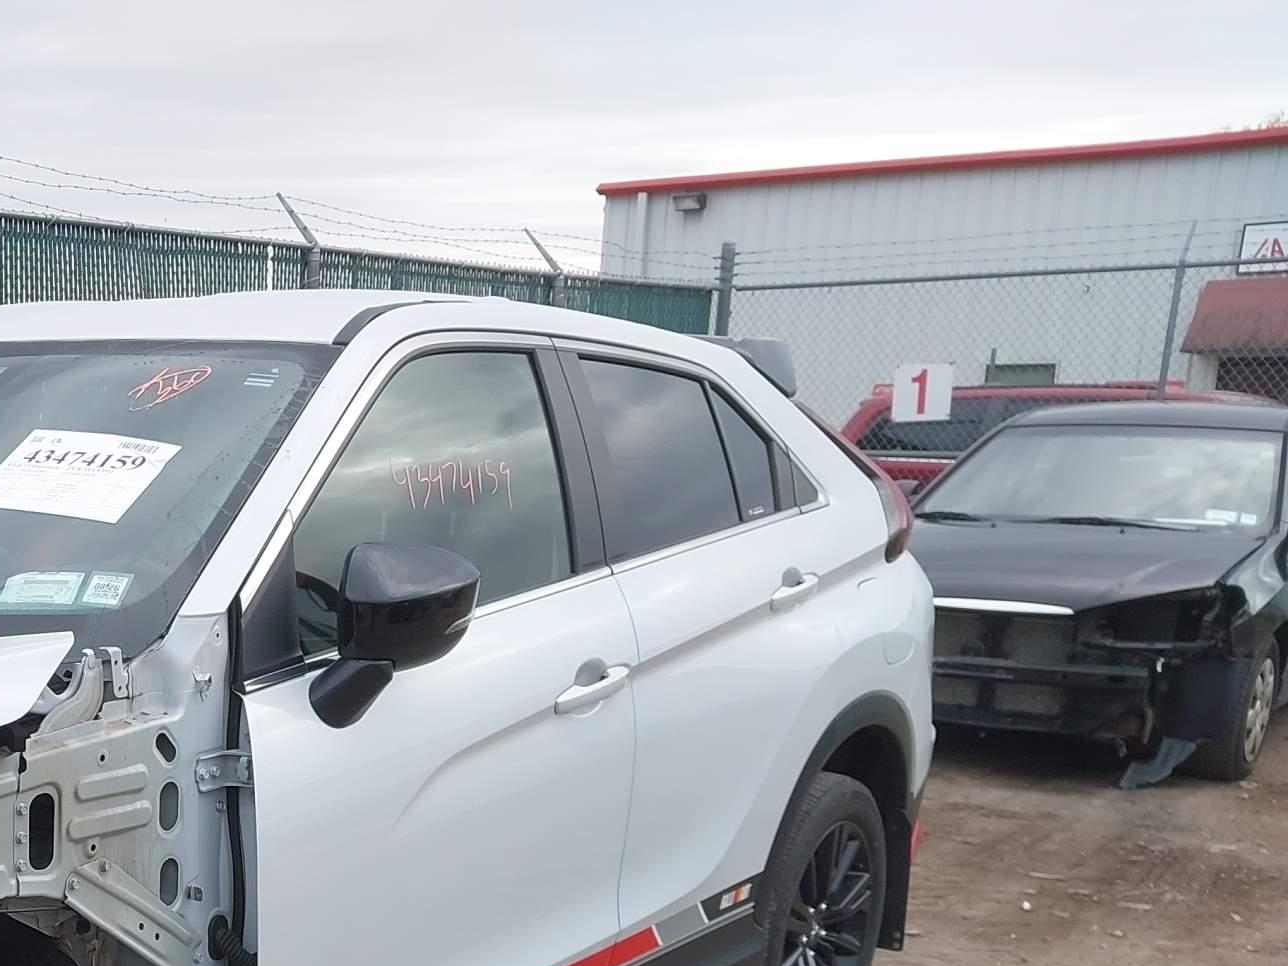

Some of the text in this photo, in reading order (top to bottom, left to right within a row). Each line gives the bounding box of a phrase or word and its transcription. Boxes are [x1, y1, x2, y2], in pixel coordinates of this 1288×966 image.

[911, 368, 928, 415] 1
[23, 449, 147, 471] 43474159
[389, 456, 513, 511] 43474159
